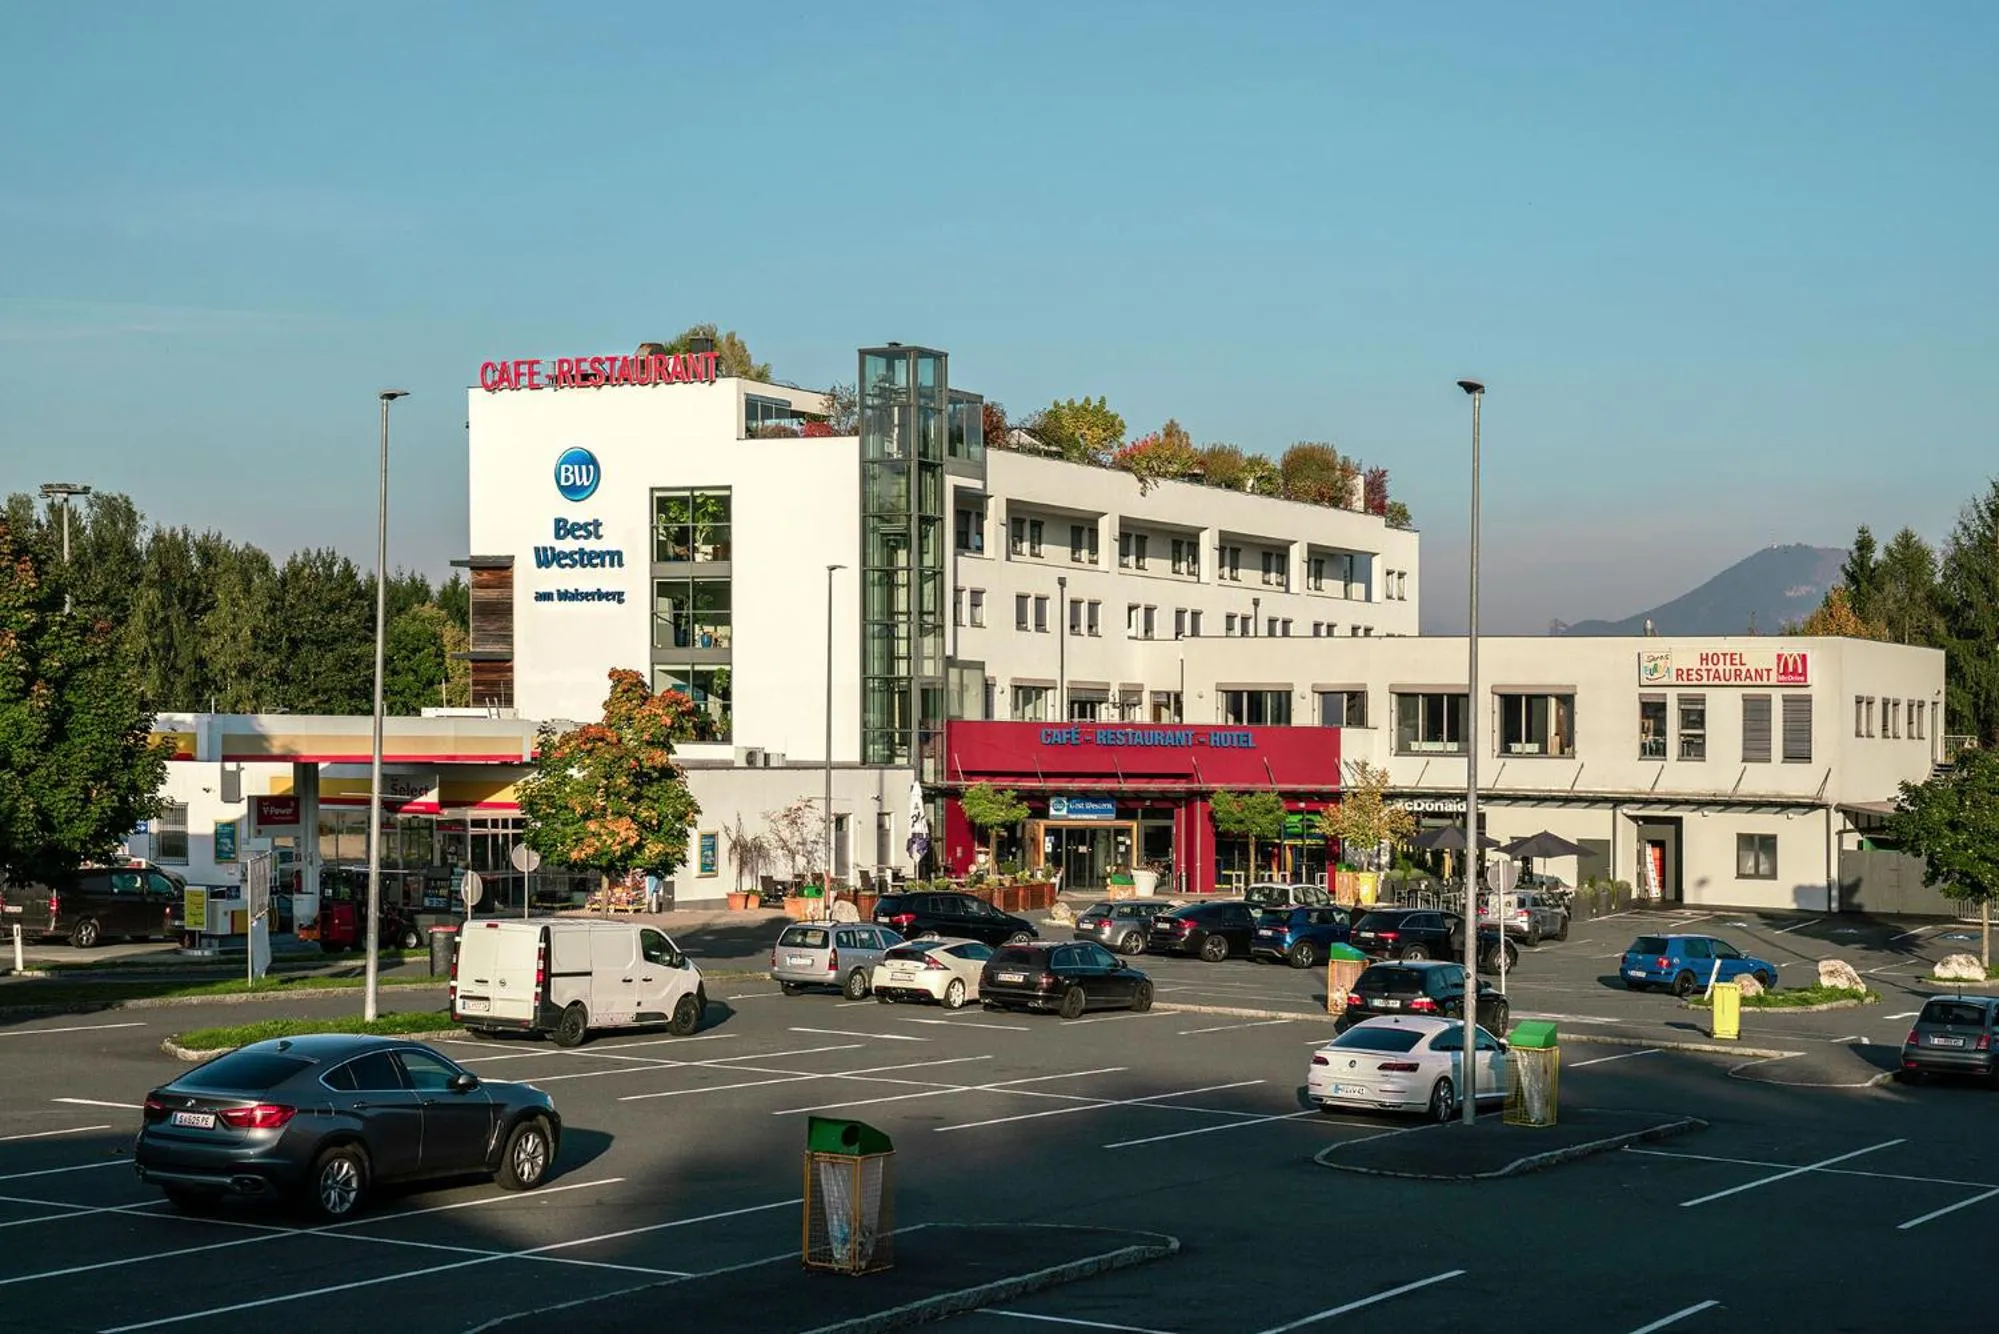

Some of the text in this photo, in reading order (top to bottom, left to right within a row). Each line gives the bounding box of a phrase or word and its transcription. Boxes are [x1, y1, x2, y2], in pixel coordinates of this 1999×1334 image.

[480, 359, 543, 391] CAFE
[556, 352, 720, 389] RESTAURANT
[560, 464, 594, 486] BW
[554, 517, 604, 541] Best
[534, 546, 625, 569] Western
[534, 591, 554, 602] am
[1700, 652, 1747, 666] HOTEL
[1675, 668, 1773, 682] RESTAURANT
[1040, 726, 1080, 745] CAFÉ
[1096, 728, 1194, 747] RESTAURANT
[1209, 732, 1256, 748] HOTEL
